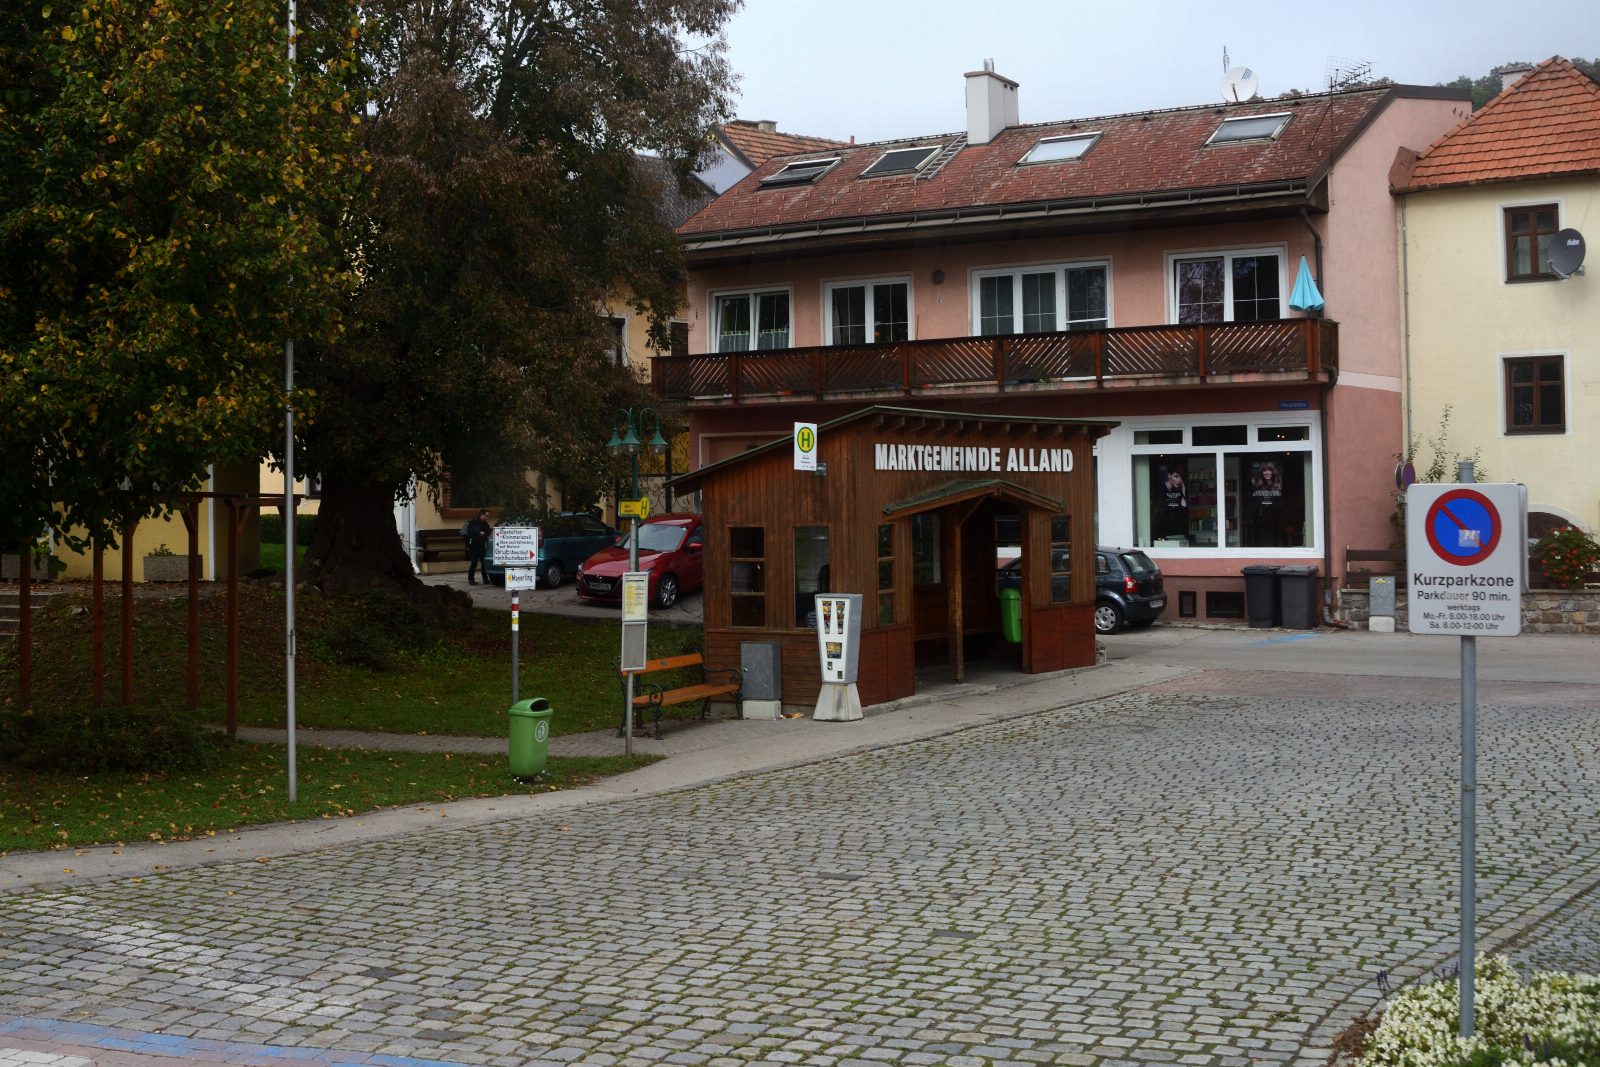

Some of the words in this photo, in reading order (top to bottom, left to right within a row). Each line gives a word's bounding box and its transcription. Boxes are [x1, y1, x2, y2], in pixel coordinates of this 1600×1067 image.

[801, 431, 811, 448] H
[874, 442, 1001, 472] MARKTGEMEINDE
[1006, 447, 1074, 473] ALLAND
[512, 573, 533, 583] Mayerling
[1414, 573, 1514, 588] Kurzparkzone
[1417, 590, 1469, 601] Parkdauer
[1471, 591, 1486, 601] 90
[1489, 591, 1511, 601] min.
[1447, 604, 1481, 612] werktags
[1423, 612, 1448, 620] Mo.-Fr.
[1491, 613, 1506, 621] Uhr
[1429, 621, 1441, 629] Sa.
[1485, 622, 1499, 630] Uhr
